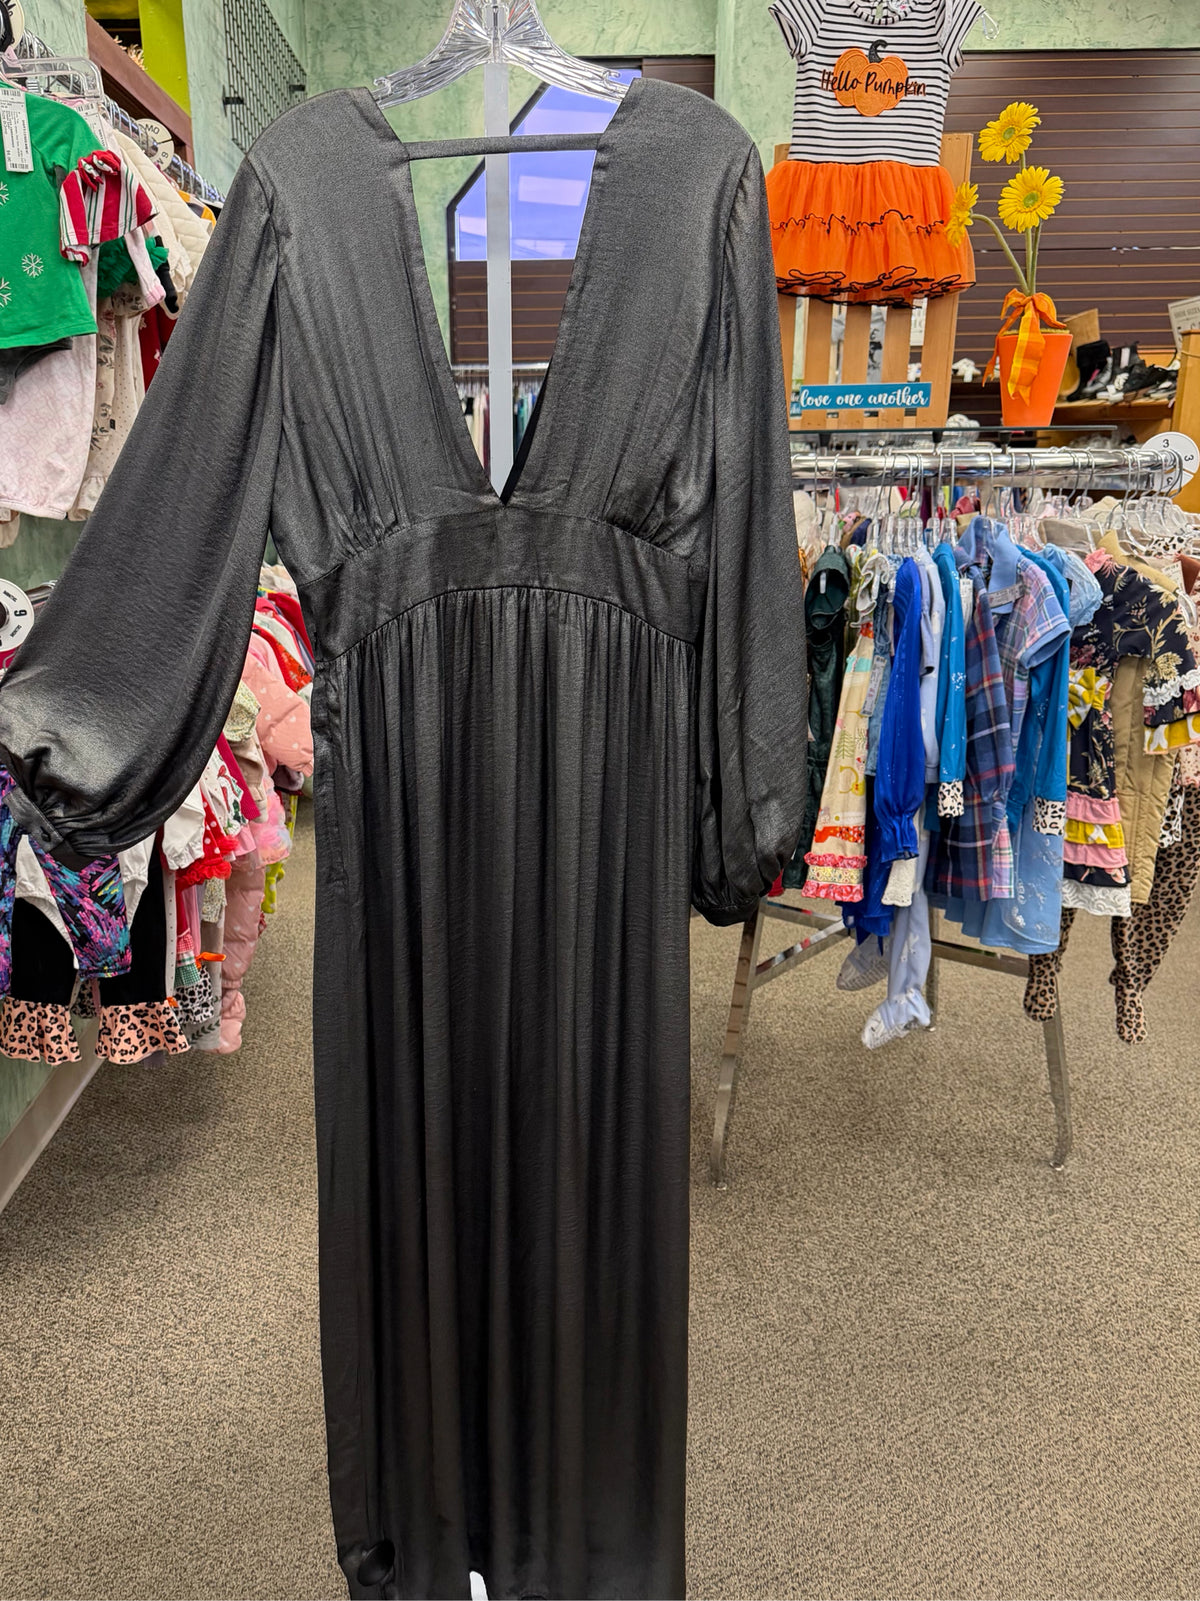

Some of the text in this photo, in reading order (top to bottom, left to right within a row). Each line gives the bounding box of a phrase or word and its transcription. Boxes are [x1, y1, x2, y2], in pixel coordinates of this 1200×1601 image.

[821, 69, 926, 99] Hello Pumpkin
[801, 389, 831, 407] love
[836, 396, 863, 406] one
[867, 386, 928, 406] another
[1163, 439, 1170, 448] 3
[1184, 454, 1194, 462] 3
